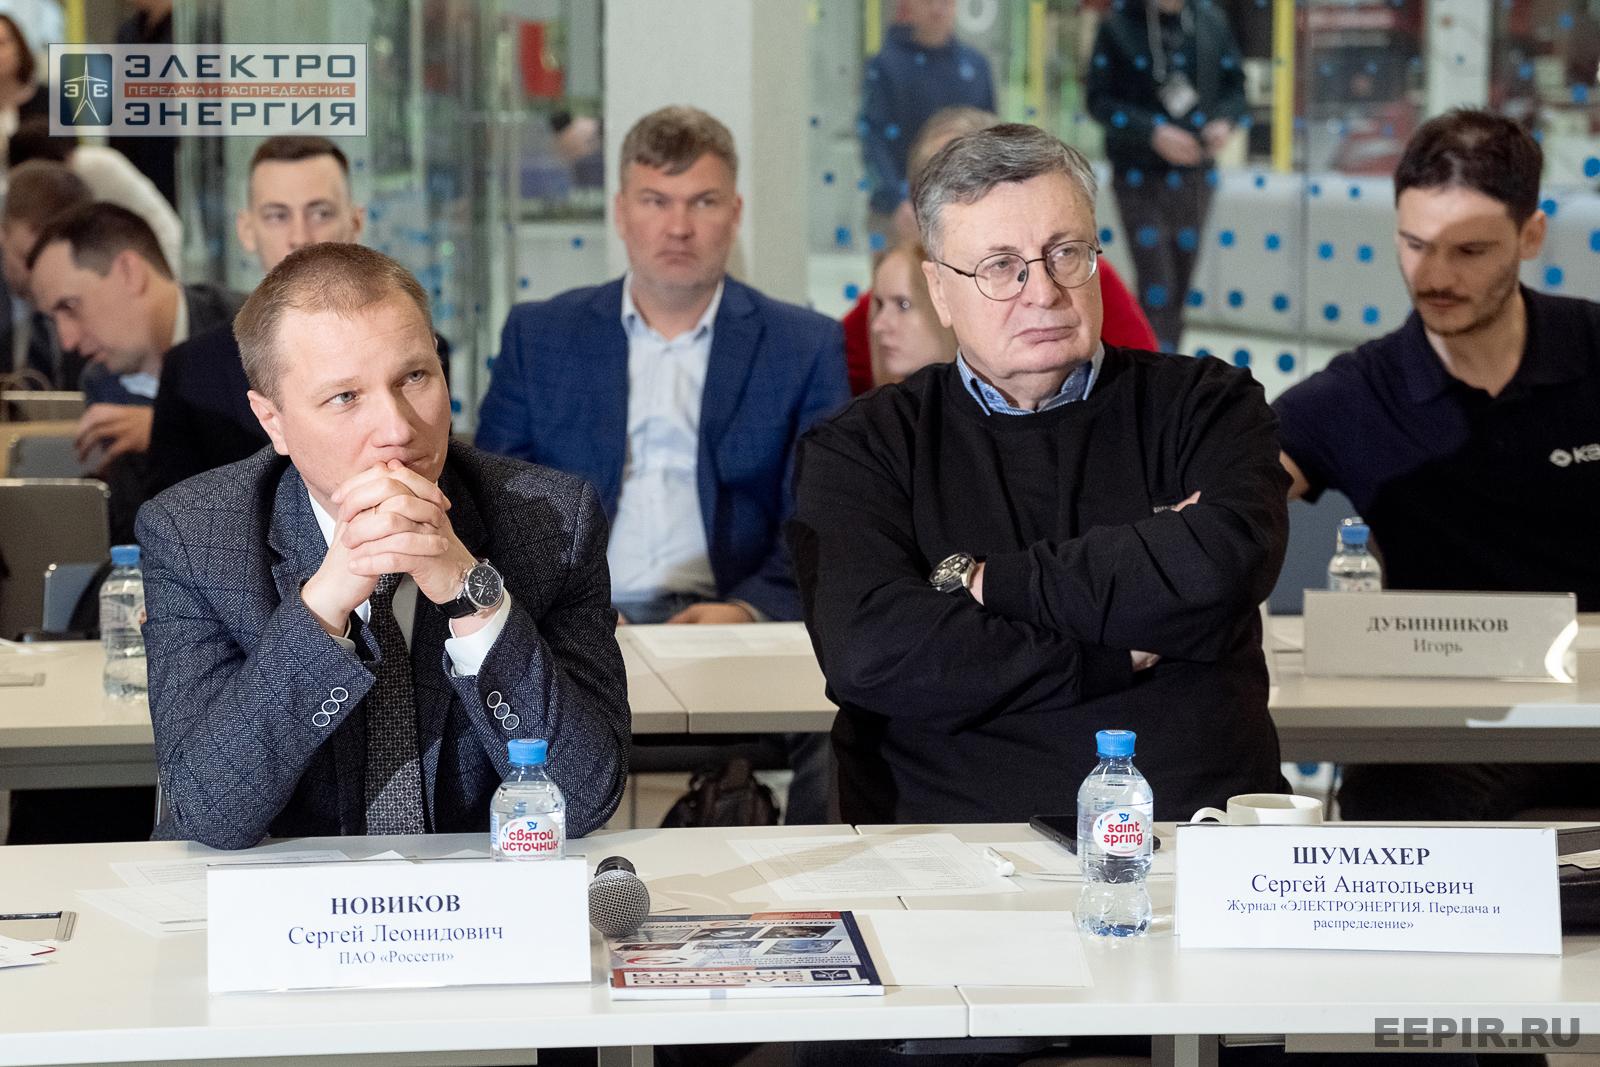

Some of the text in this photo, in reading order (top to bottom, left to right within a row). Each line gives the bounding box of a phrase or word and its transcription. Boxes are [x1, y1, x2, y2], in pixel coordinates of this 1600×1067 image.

[1366, 616, 1509, 633] ДУБИННИКОВ
[1413, 638, 1463, 657] Игорь
[1107, 821, 1140, 832] saint
[1103, 832, 1143, 846] spring
[1292, 846, 1431, 866] ШУМАХЕР
[1251, 874, 1474, 897] Сергей Анатольевич
[331, 894, 461, 915] НОВИКОВ
[1226, 900, 1501, 915] Журнал «ЭЛЕКТРОЭНЕРГИЯ. Передача и
[1313, 918, 1415, 931] распределение»
[288, 925, 503, 949] Сергей Леонидович
[339, 950, 455, 965] ПАО «Россети»
